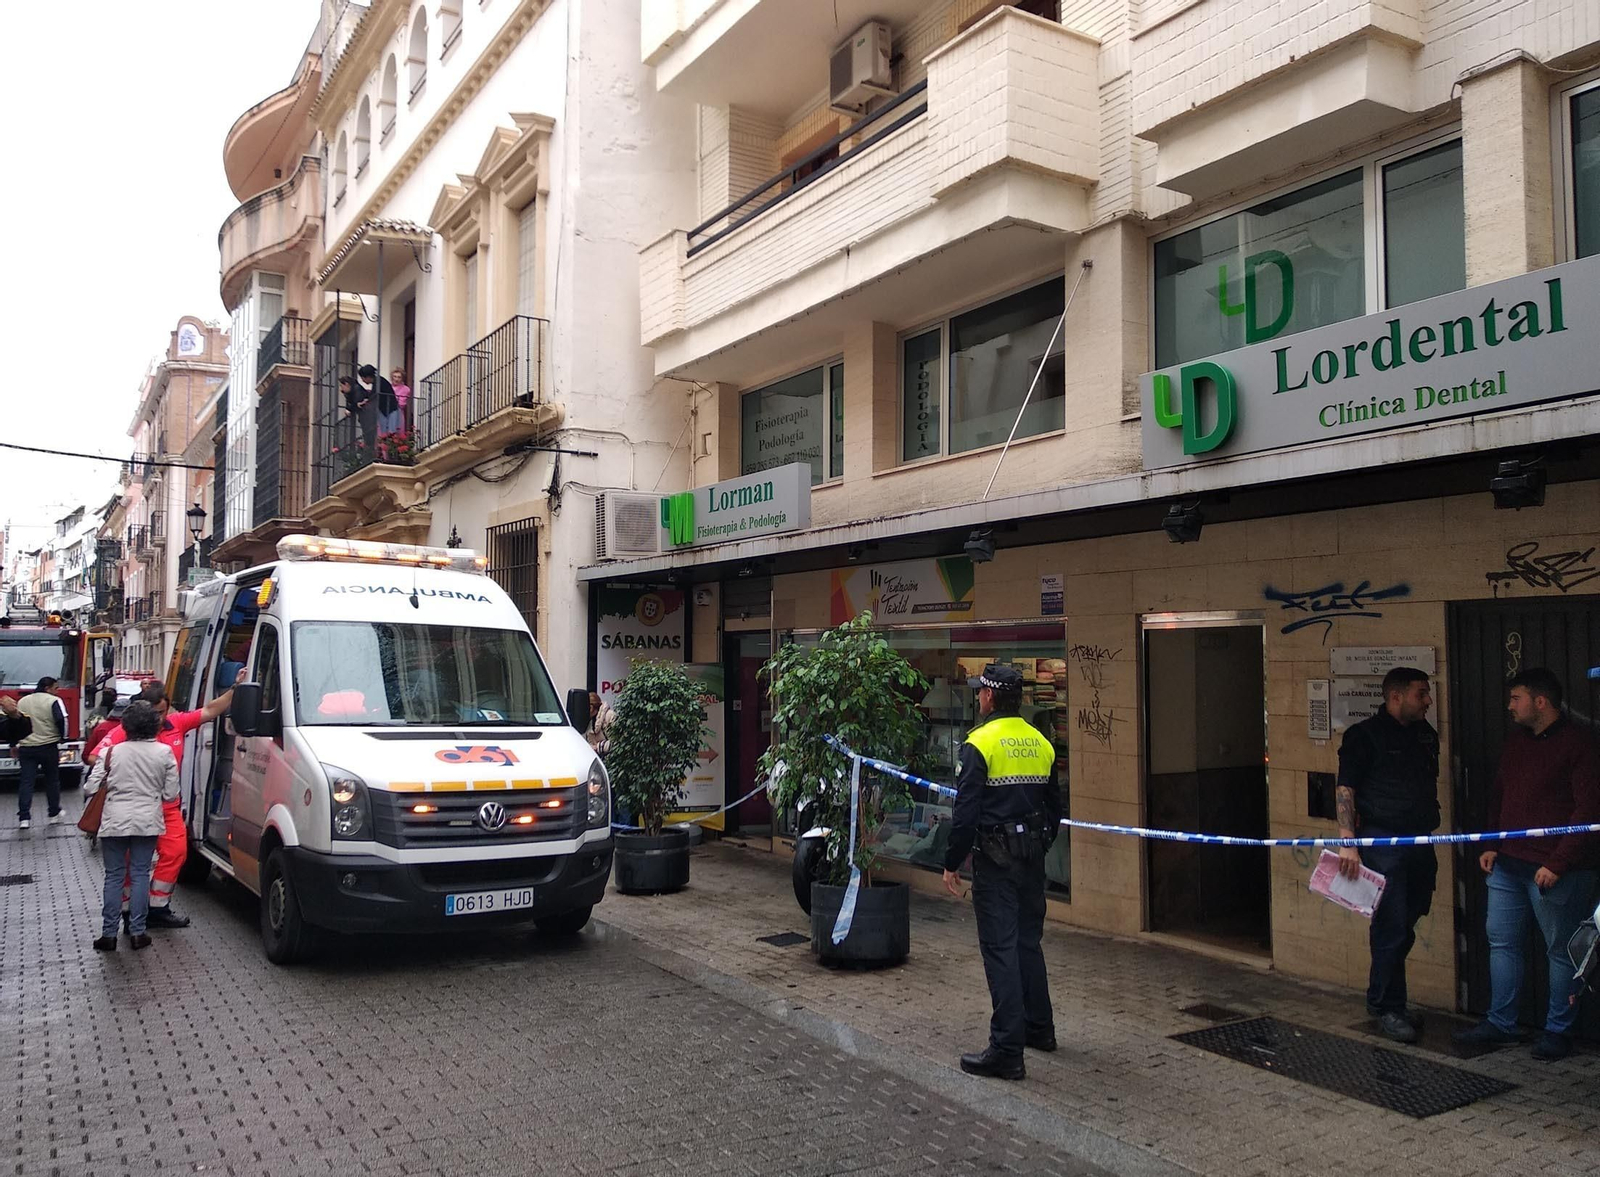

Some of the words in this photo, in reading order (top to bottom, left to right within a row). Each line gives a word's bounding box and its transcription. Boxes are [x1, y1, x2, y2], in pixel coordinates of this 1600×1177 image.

[1271, 277, 1568, 395] Lordental
[1319, 396, 1406, 428] Clínica
[1414, 370, 1508, 411] Dental
[755, 406, 809, 433] Fisioterapia
[759, 429, 805, 452] Podología
[708, 480, 774, 513] Lorman
[697, 520, 738, 539] Fisioterapia
[739, 518, 747, 530] &
[749, 510, 787, 530] Podología
[601, 632, 681, 649] SÁBANAS
[1000, 738, 1041, 748] POLICIA
[1008, 748, 1039, 758] LOCAL
[456, 894, 494, 912] 0613
[504, 890, 532, 908] HJD
